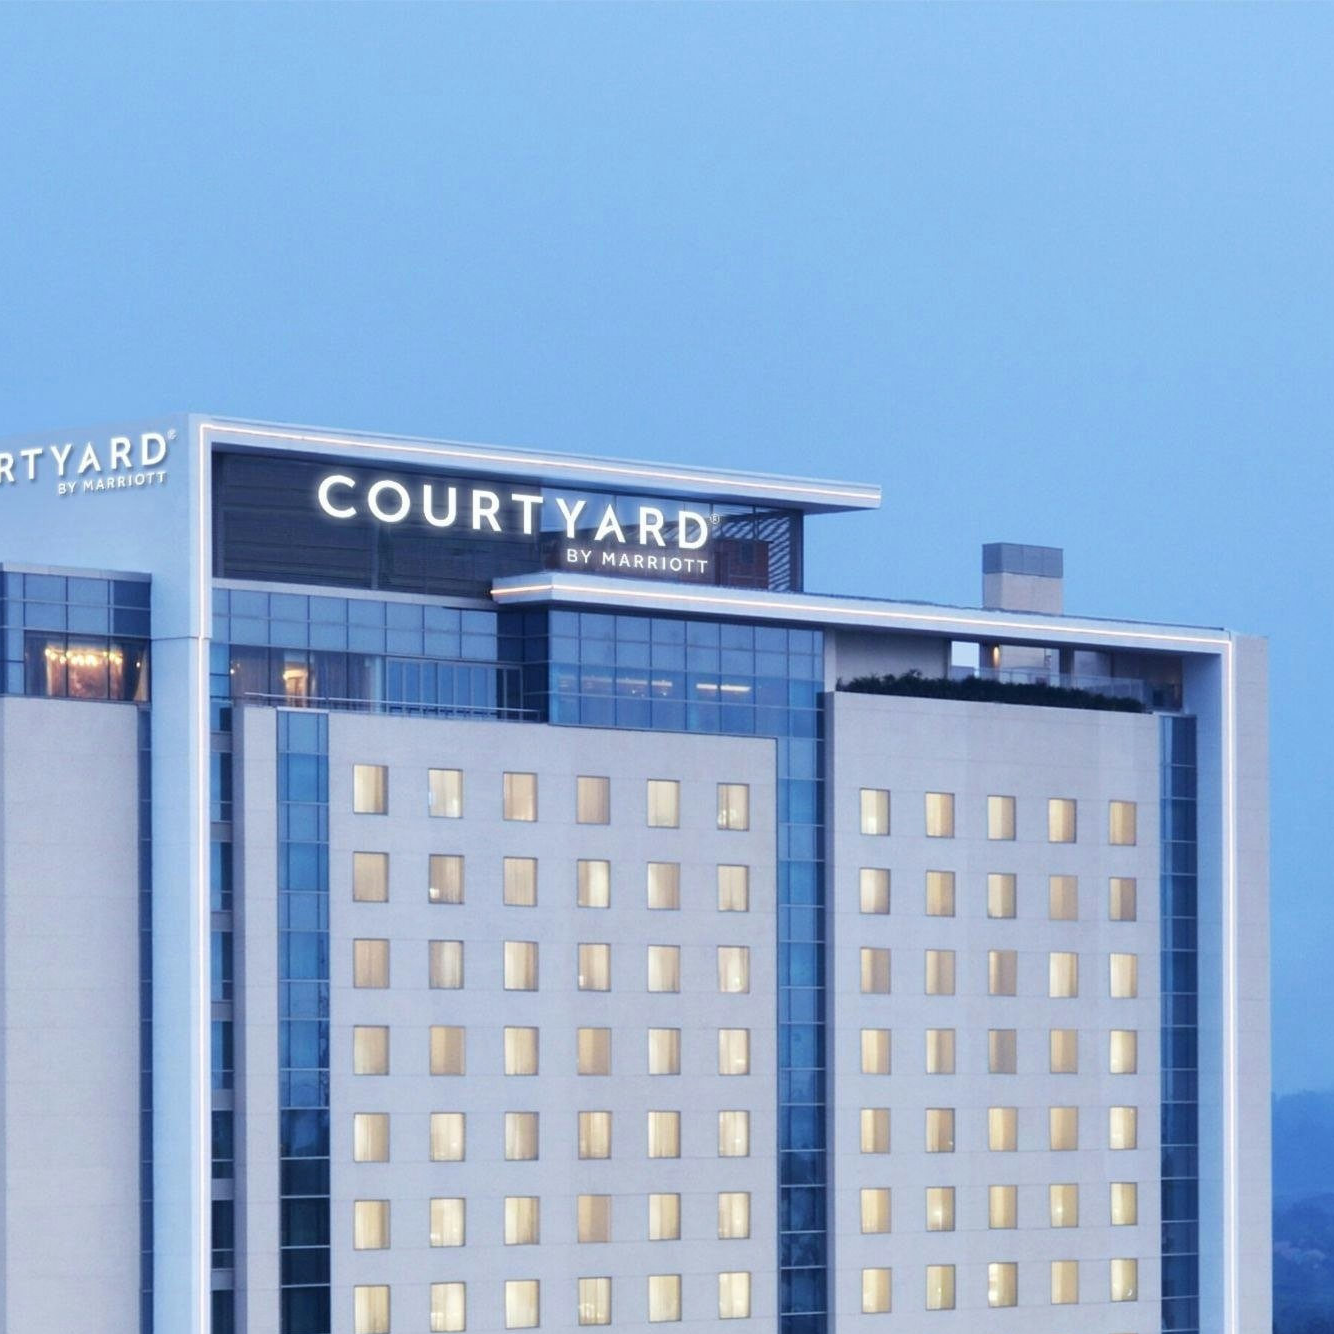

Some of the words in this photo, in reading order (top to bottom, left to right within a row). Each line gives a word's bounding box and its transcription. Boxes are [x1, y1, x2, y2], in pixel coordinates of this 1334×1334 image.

[58, 481, 76, 495] BY
[83, 471, 167, 492] MARRIOTT
[566, 548, 592, 564] BY
[601, 551, 708, 574] MARRIOTT
